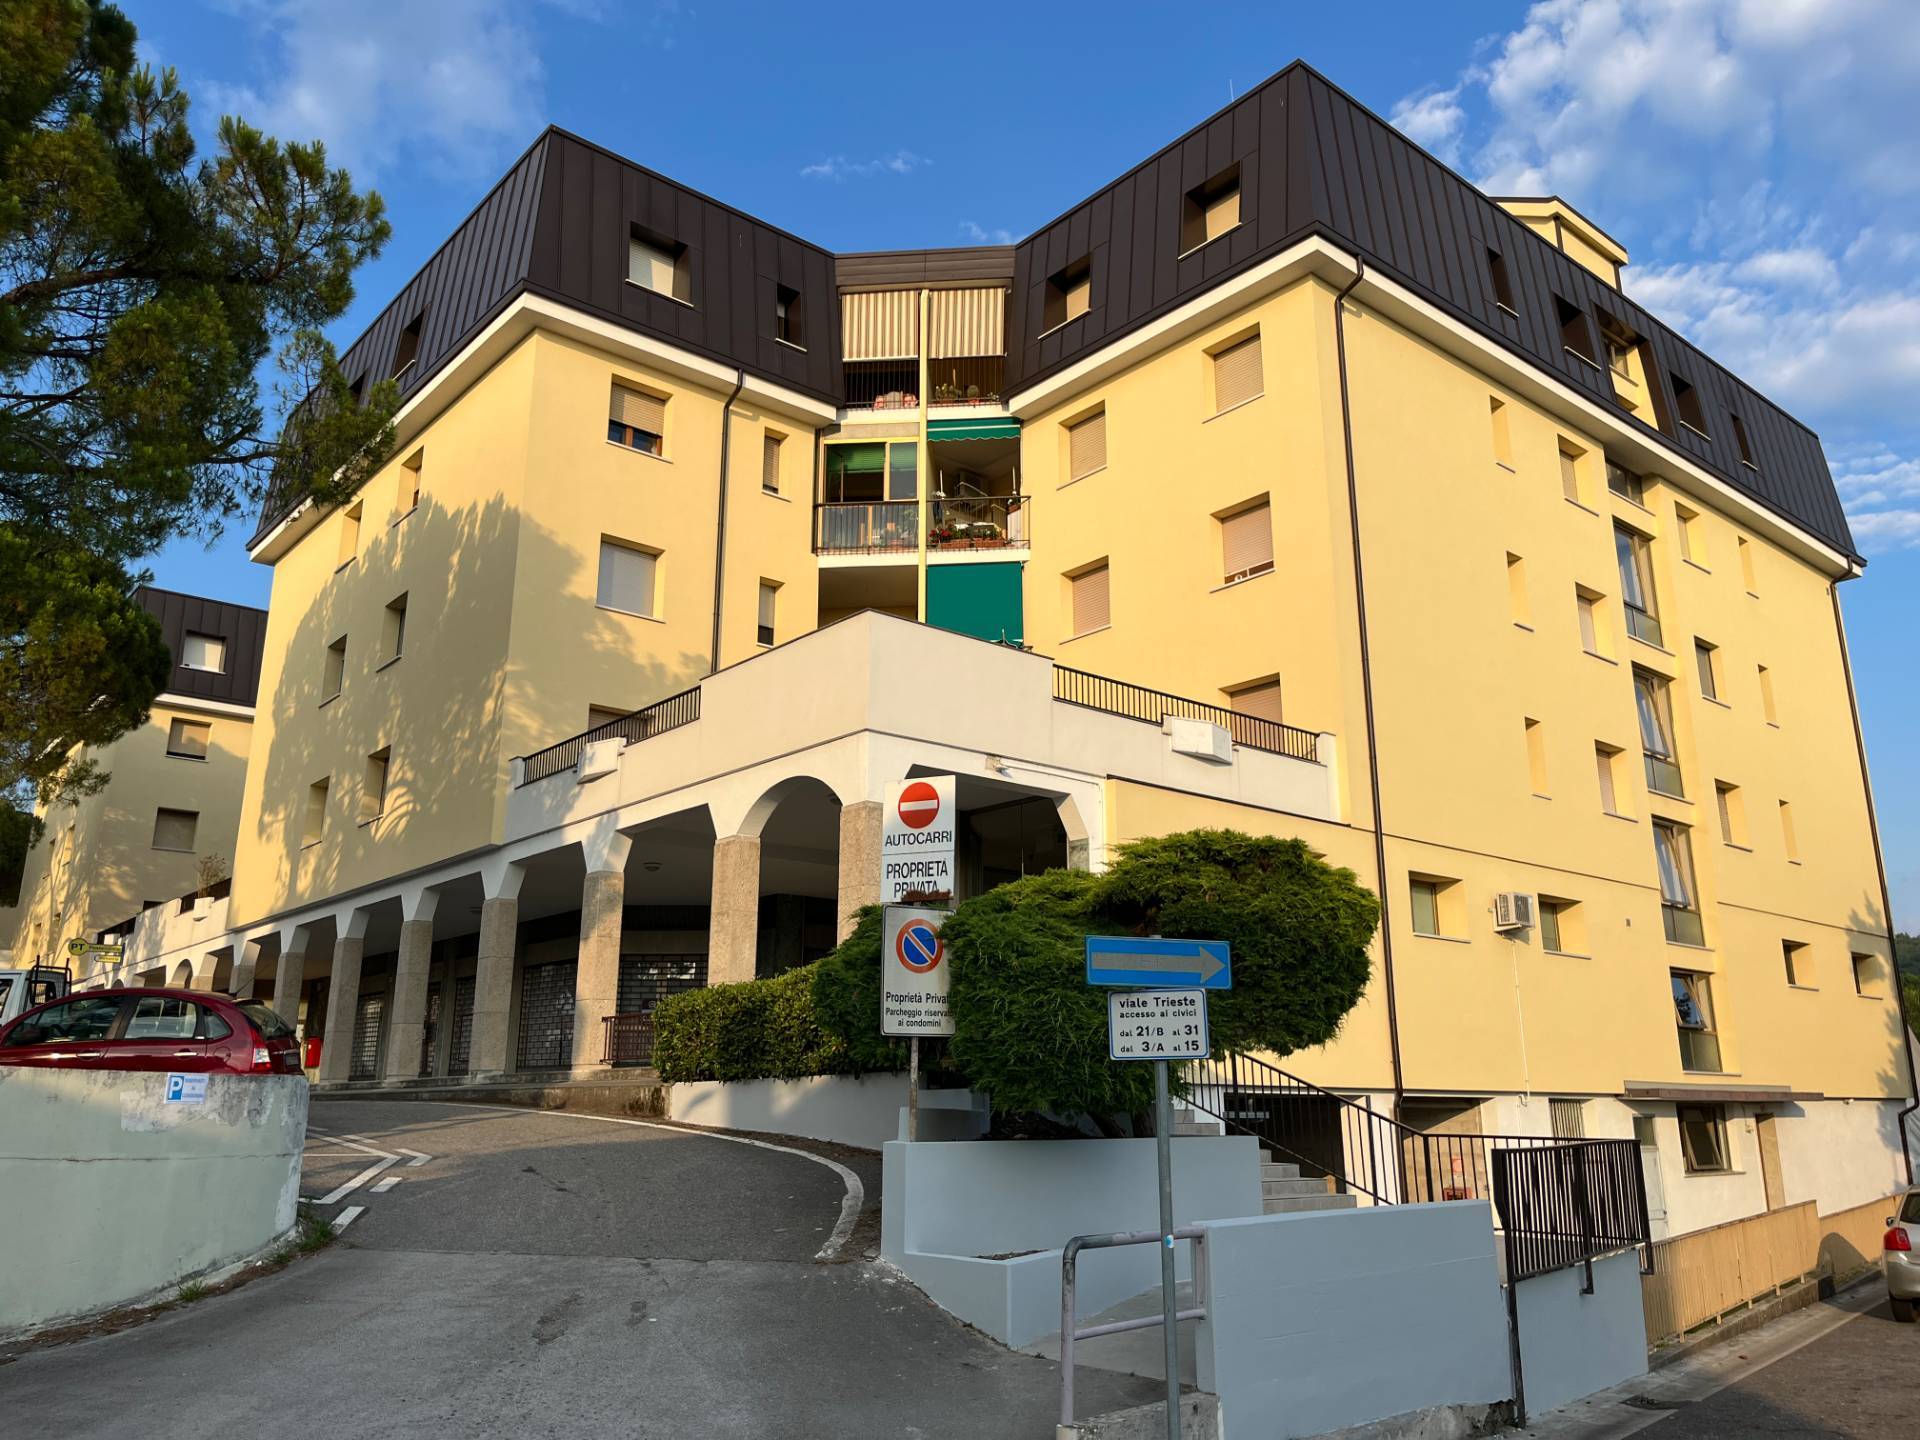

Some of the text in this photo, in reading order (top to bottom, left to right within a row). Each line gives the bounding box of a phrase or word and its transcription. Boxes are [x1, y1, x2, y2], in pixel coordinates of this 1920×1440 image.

[885, 831, 952, 847] AUTOCARRI
[71, 943, 85, 951] PT
[885, 991, 949, 1005] Proprietà Privat
[1119, 996, 1196, 1008] viale Trieste
[885, 1007, 922, 1018] Parcheggio
[1119, 1008, 1197, 1018] accesso ai civici
[898, 1018, 941, 1027] ai condomini
[1120, 1029, 1133, 1037] dal
[1135, 1026, 1164, 1037] 21/B
[1184, 1024, 1199, 1035] 31
[1120, 1045, 1133, 1053] dal
[1141, 1041, 1164, 1052] 3/A
[1184, 1040, 1199, 1051] 15
[168, 1077, 183, 1099] P
